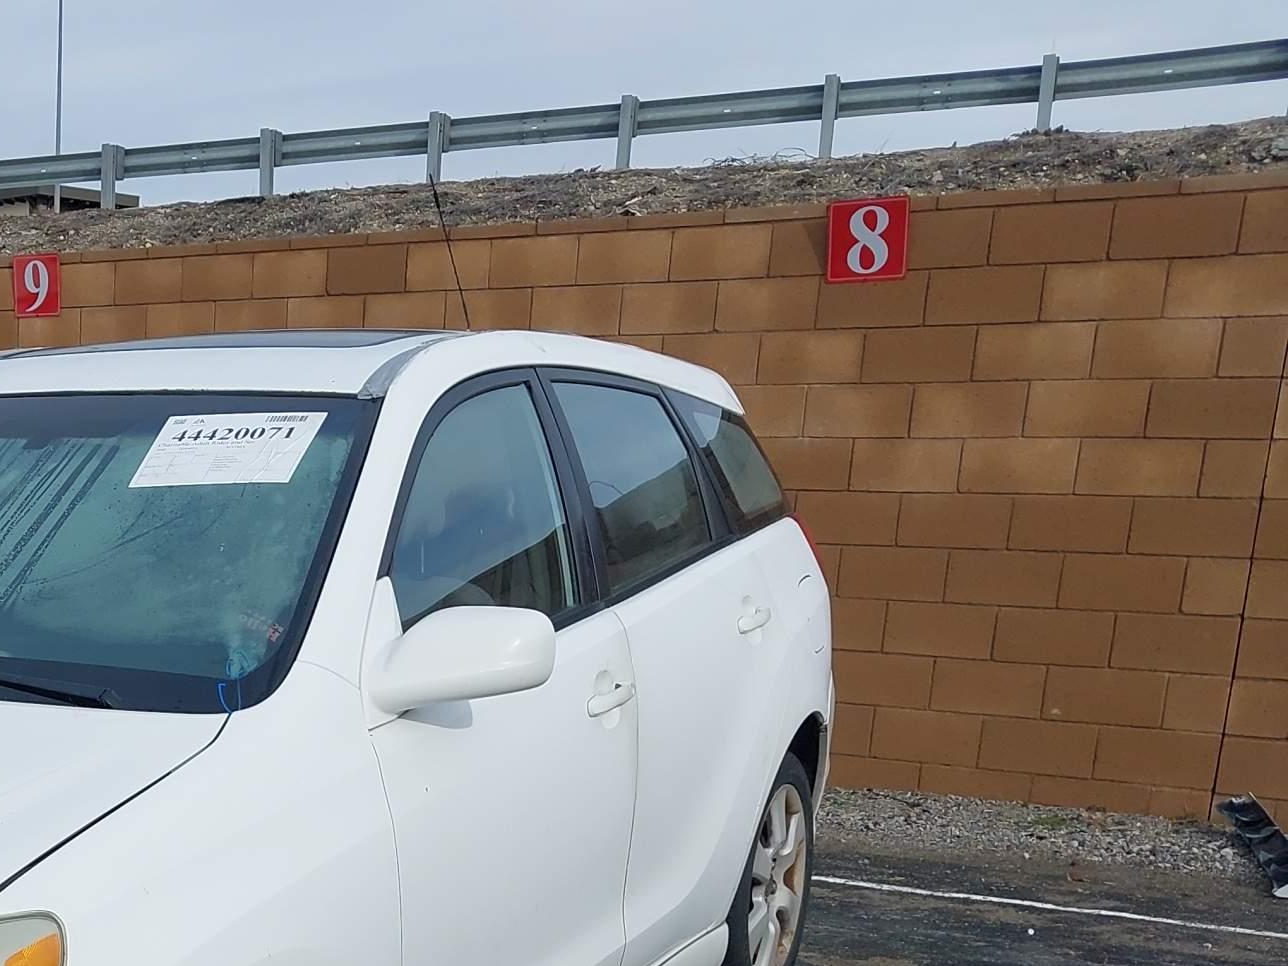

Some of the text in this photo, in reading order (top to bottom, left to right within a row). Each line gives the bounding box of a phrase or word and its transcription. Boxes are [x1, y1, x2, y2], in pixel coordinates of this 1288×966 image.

[847, 205, 889, 274] 8
[24, 259, 49, 312] 9
[172, 427, 295, 441] 44420071
